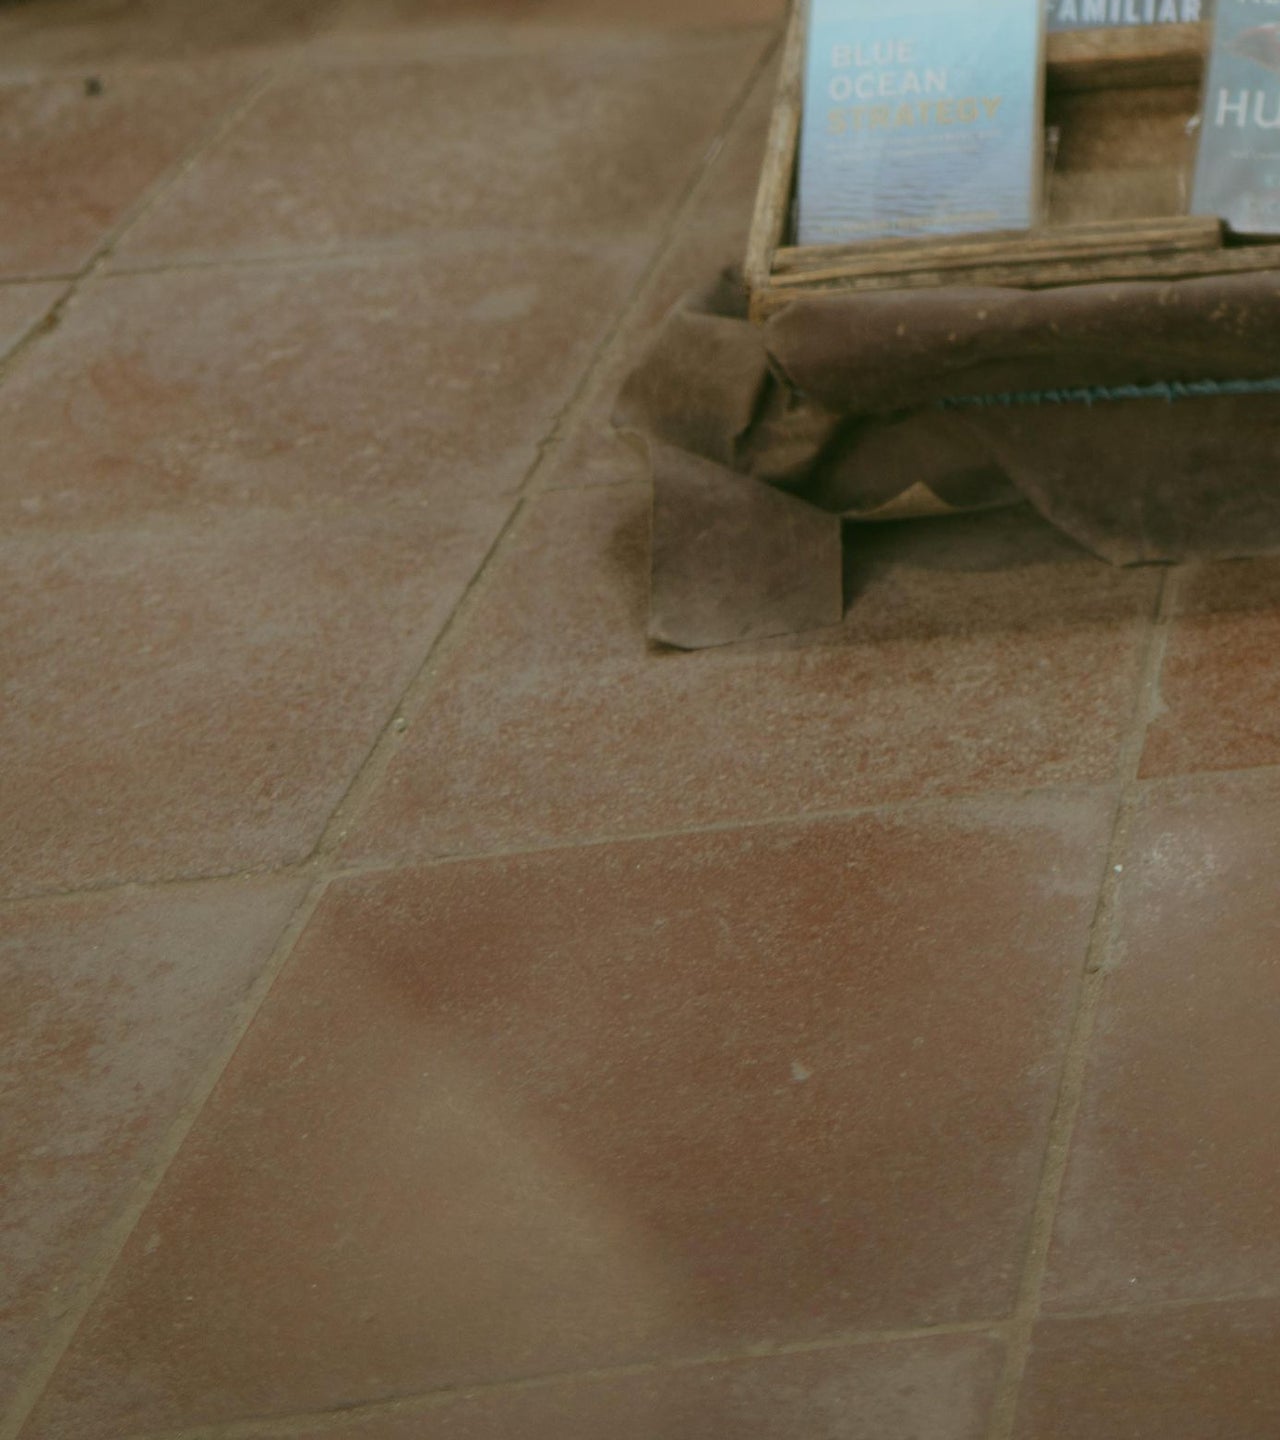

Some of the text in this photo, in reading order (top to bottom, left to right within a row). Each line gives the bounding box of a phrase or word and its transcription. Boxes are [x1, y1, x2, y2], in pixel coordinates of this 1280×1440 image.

[829, 36, 916, 71] BLUE
[828, 67, 948, 103] OCEAN
[825, 93, 1002, 137] STRATEGY
